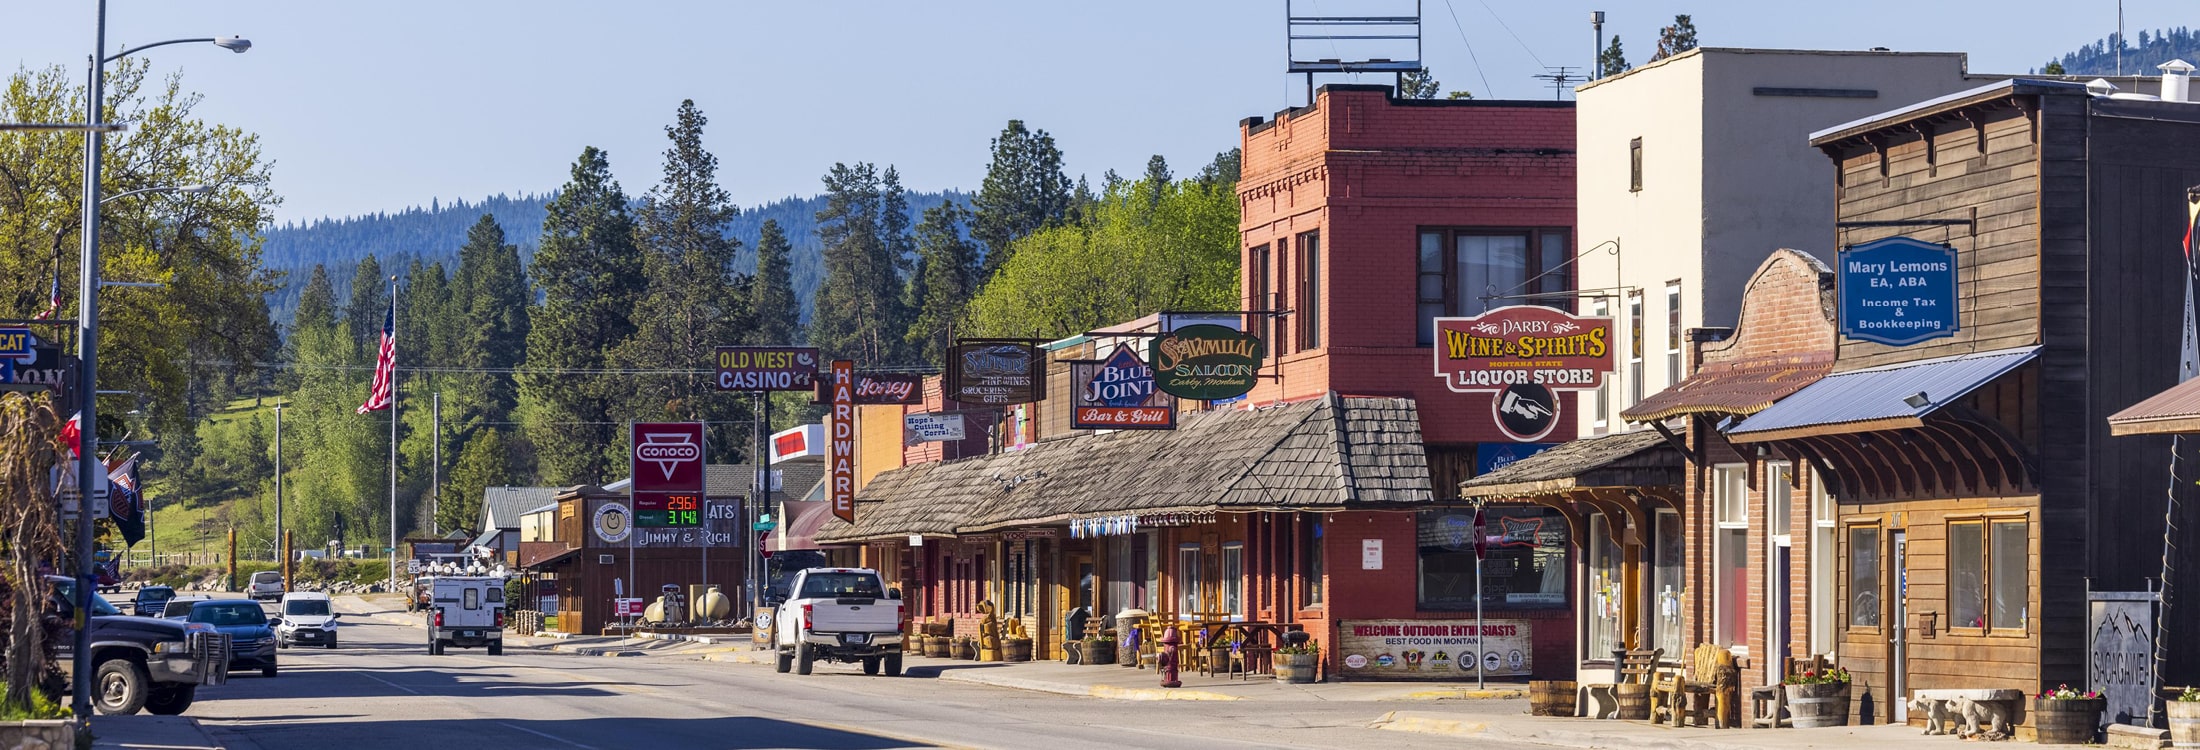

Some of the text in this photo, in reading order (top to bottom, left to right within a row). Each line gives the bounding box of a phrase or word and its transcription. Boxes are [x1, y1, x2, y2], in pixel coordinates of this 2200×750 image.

[1849, 261, 1948, 276] Mary Lemons
[1870, 277, 1927, 289] EA, ABA
[1862, 298, 1936, 307] Income Tax
[1895, 308, 1904, 317] &
[1503, 319, 1550, 336] DARBY
[1859, 319, 1941, 330] Bookkeeping
[1444, 326, 1607, 359] WINE & SPIRITS
[720, 352, 795, 369] OLD WEST
[1159, 336, 1256, 371] SAWMILL
[1104, 365, 1153, 383] BLUE
[1175, 363, 1253, 376] SALOON
[719, 371, 792, 388] CASINO
[982, 377, 1031, 386] FINE WINES
[1169, 377, 1245, 389] Darby, Montana
[1459, 369, 1594, 386] LIQUOR STORE
[856, 377, 914, 400] Honey
[962, 386, 1007, 395] GROCERIES
[1084, 380, 1155, 402] JOINT
[983, 394, 1009, 403] GIFTS
[1082, 408, 1164, 423] Bar & Grill
[914, 423, 945, 431] Cutting
[924, 429, 949, 437] Corral
[834, 368, 852, 511] HARDWARE
[640, 531, 677, 546] JIMMY
[683, 534, 694, 543] &
[1353, 625, 1401, 637] WELCOME
[1402, 625, 1449, 637] OUTDOOR
[1443, 637, 1484, 645] MONTAN
